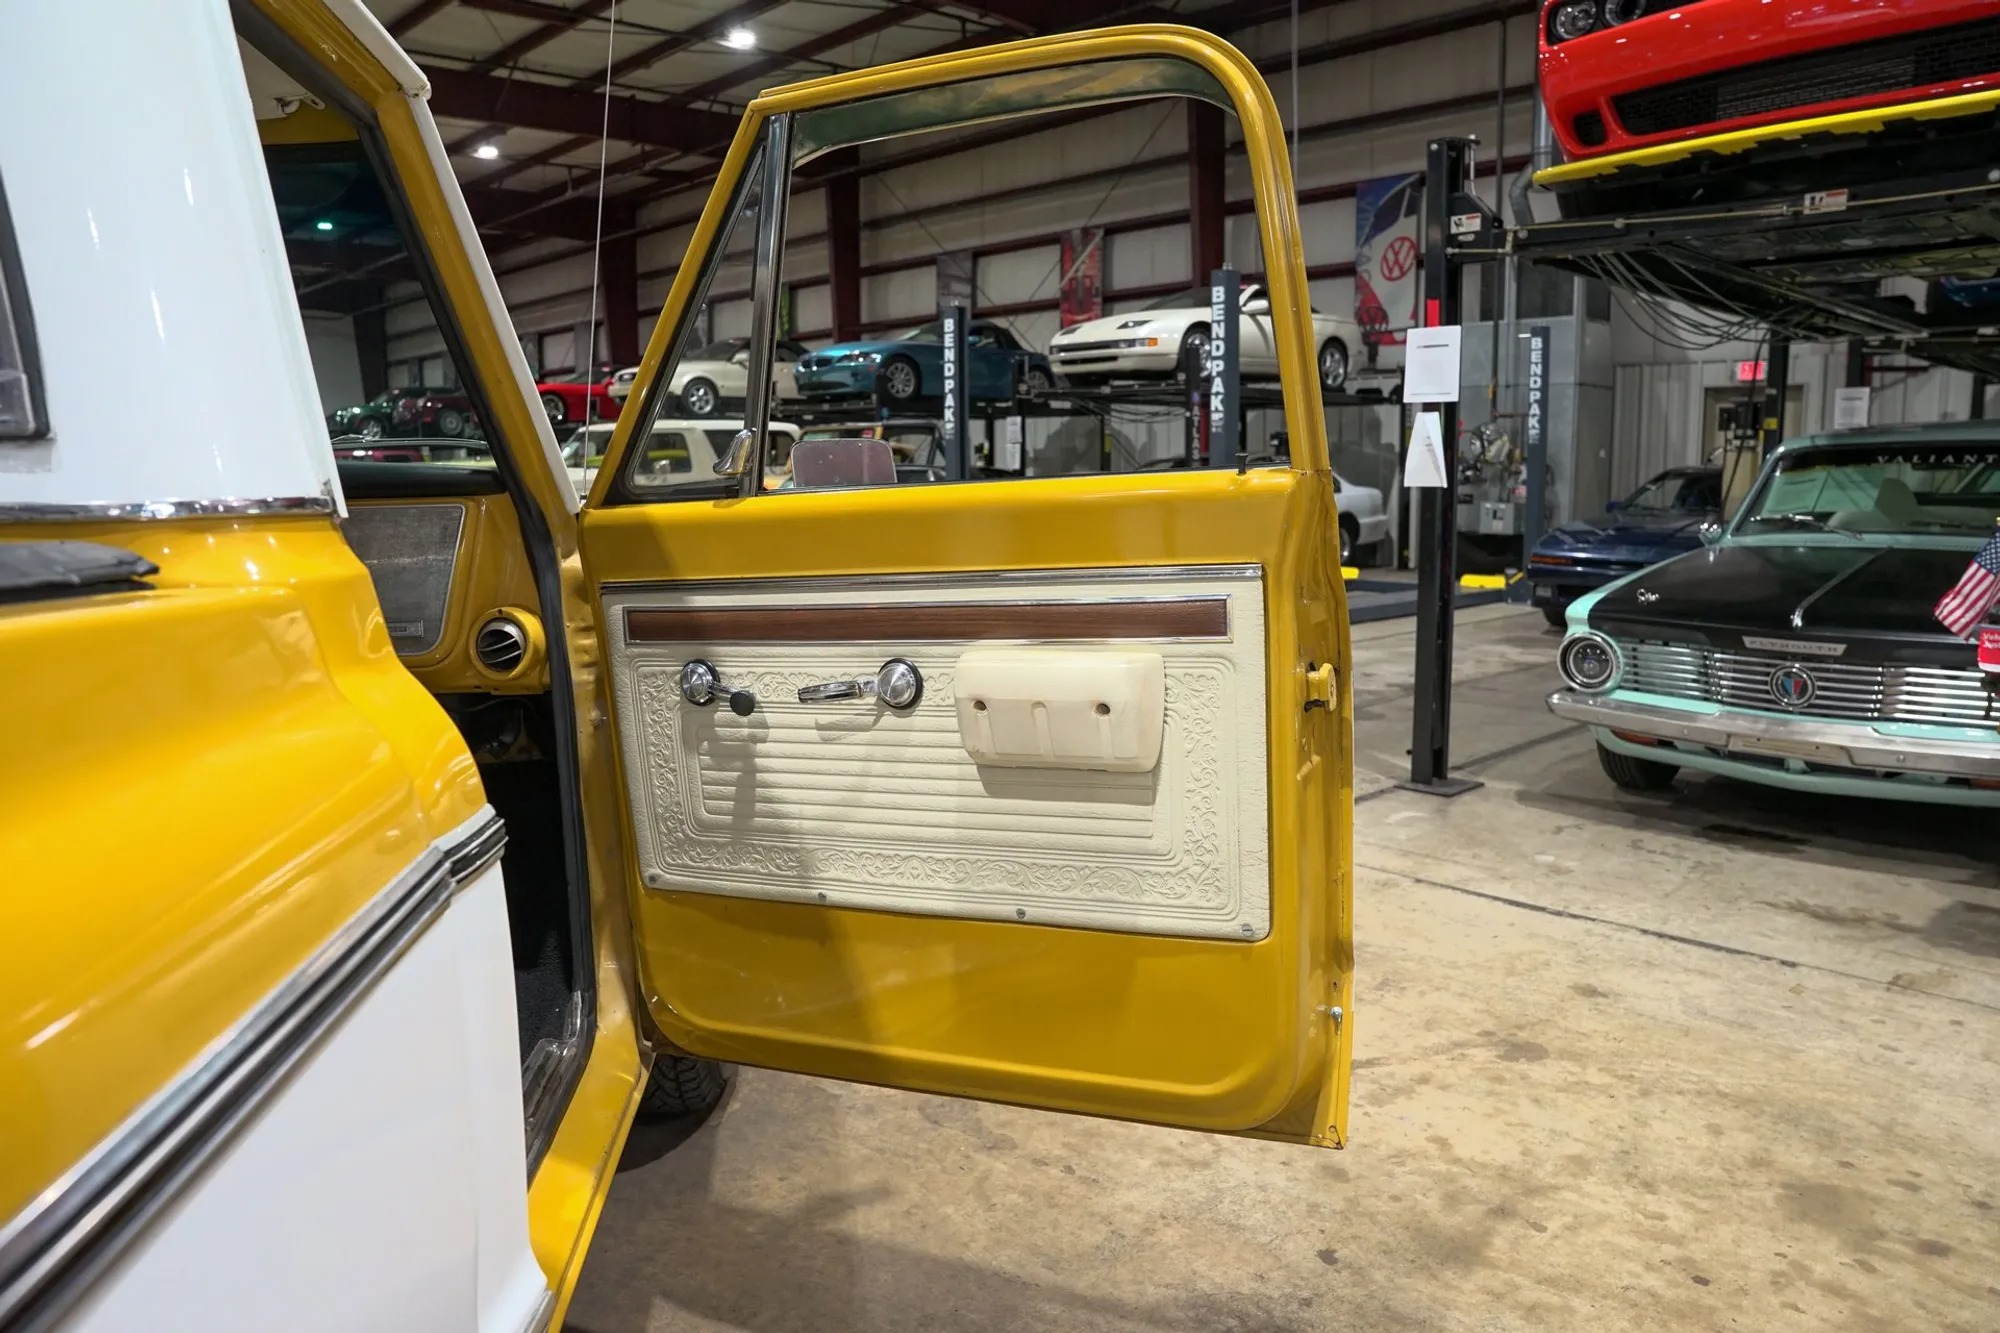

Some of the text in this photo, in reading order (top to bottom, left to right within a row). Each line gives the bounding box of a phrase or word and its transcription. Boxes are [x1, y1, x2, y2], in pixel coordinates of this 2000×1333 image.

[943, 318, 955, 421] BENDPAK
[1210, 286, 1226, 411] BENDPAK
[1528, 337, 1543, 429] BENDPAK
[1192, 405, 1201, 460] ATLAS
[1876, 453, 1999, 464] VALIANT
[1748, 640, 1839, 653] PLYMOUTH
